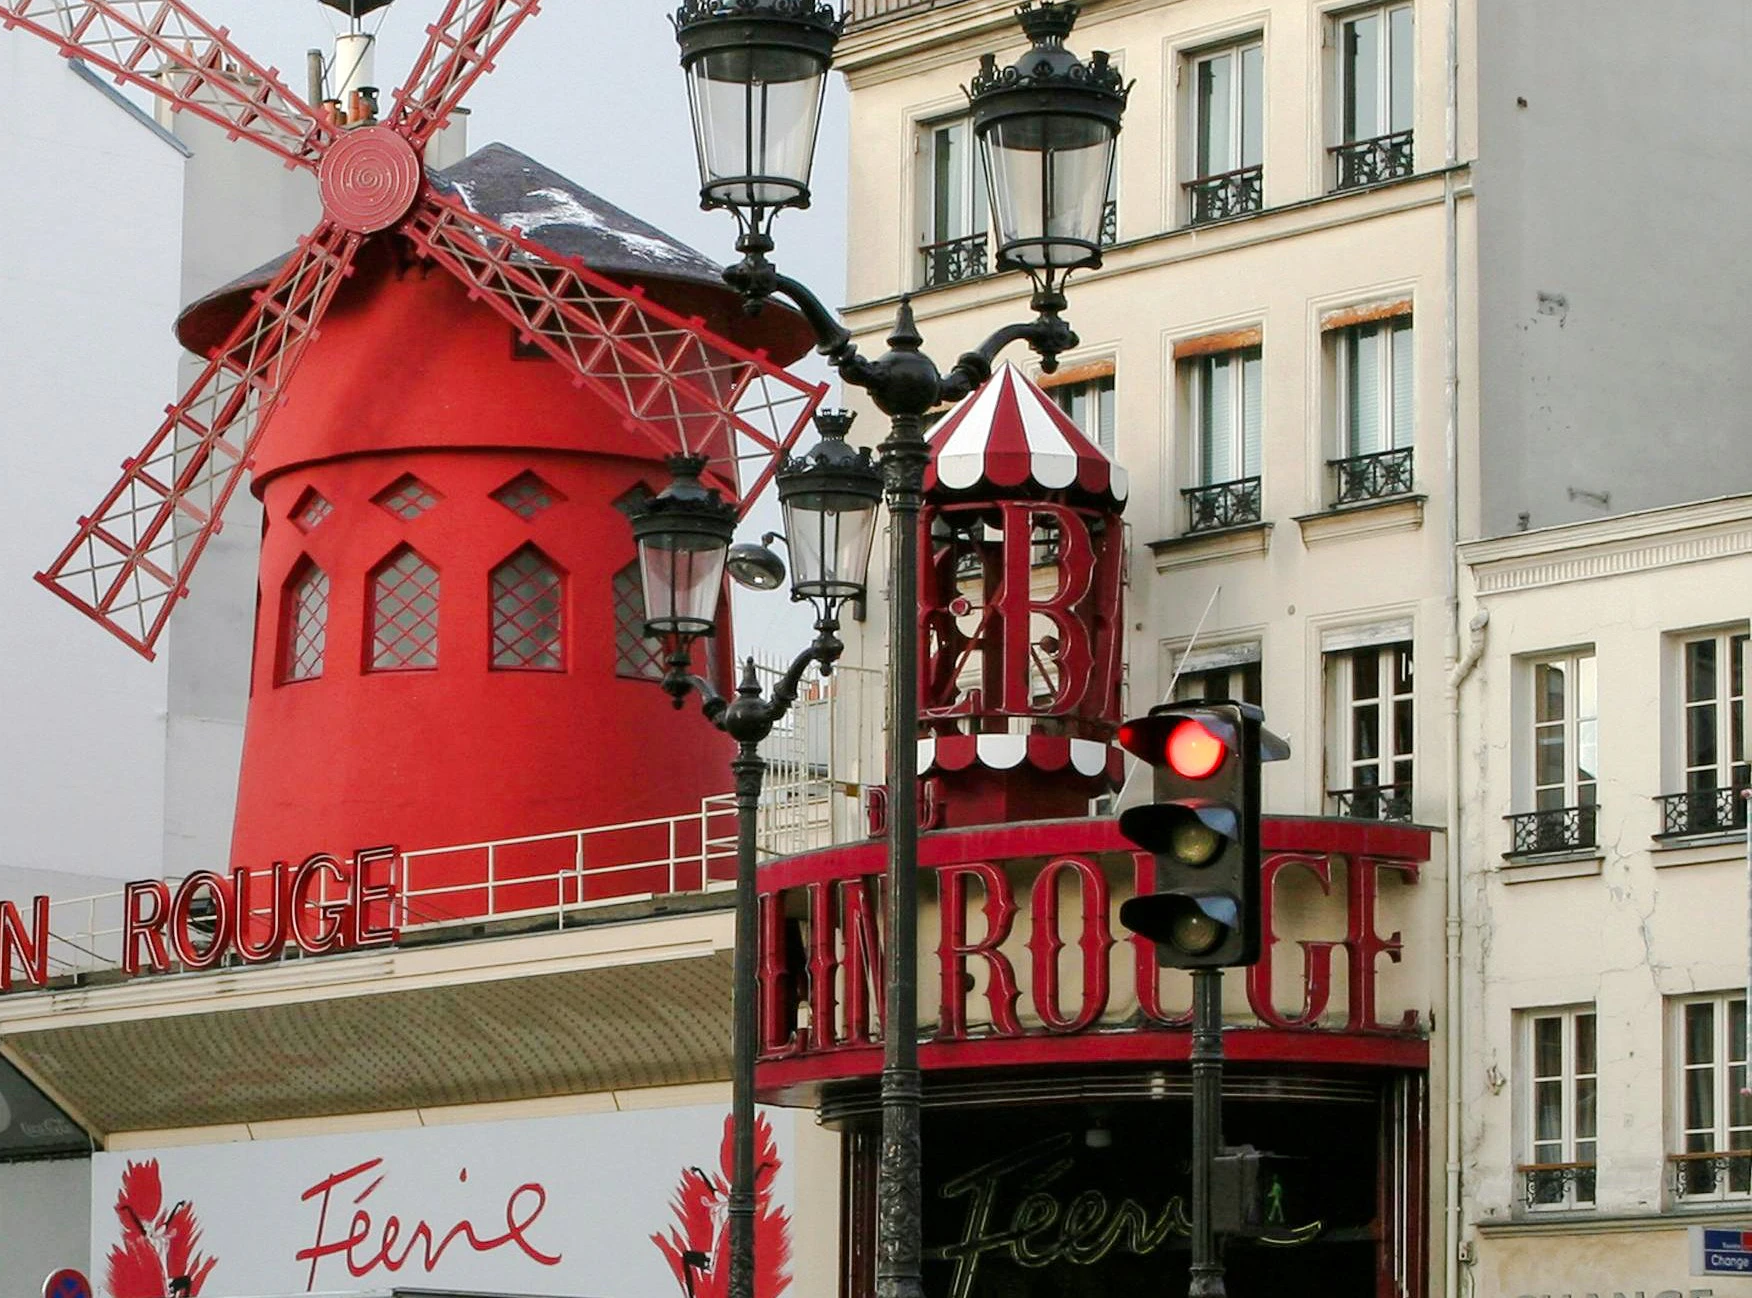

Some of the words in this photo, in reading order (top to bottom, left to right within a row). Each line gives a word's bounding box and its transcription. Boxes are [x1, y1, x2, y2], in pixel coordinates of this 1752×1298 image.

[123, 844, 400, 976] ROUGE
[296, 1156, 563, 1292] Féerie
[938, 1131, 1323, 1298] Féeri
[1711, 1253, 1750, 1270] Change
